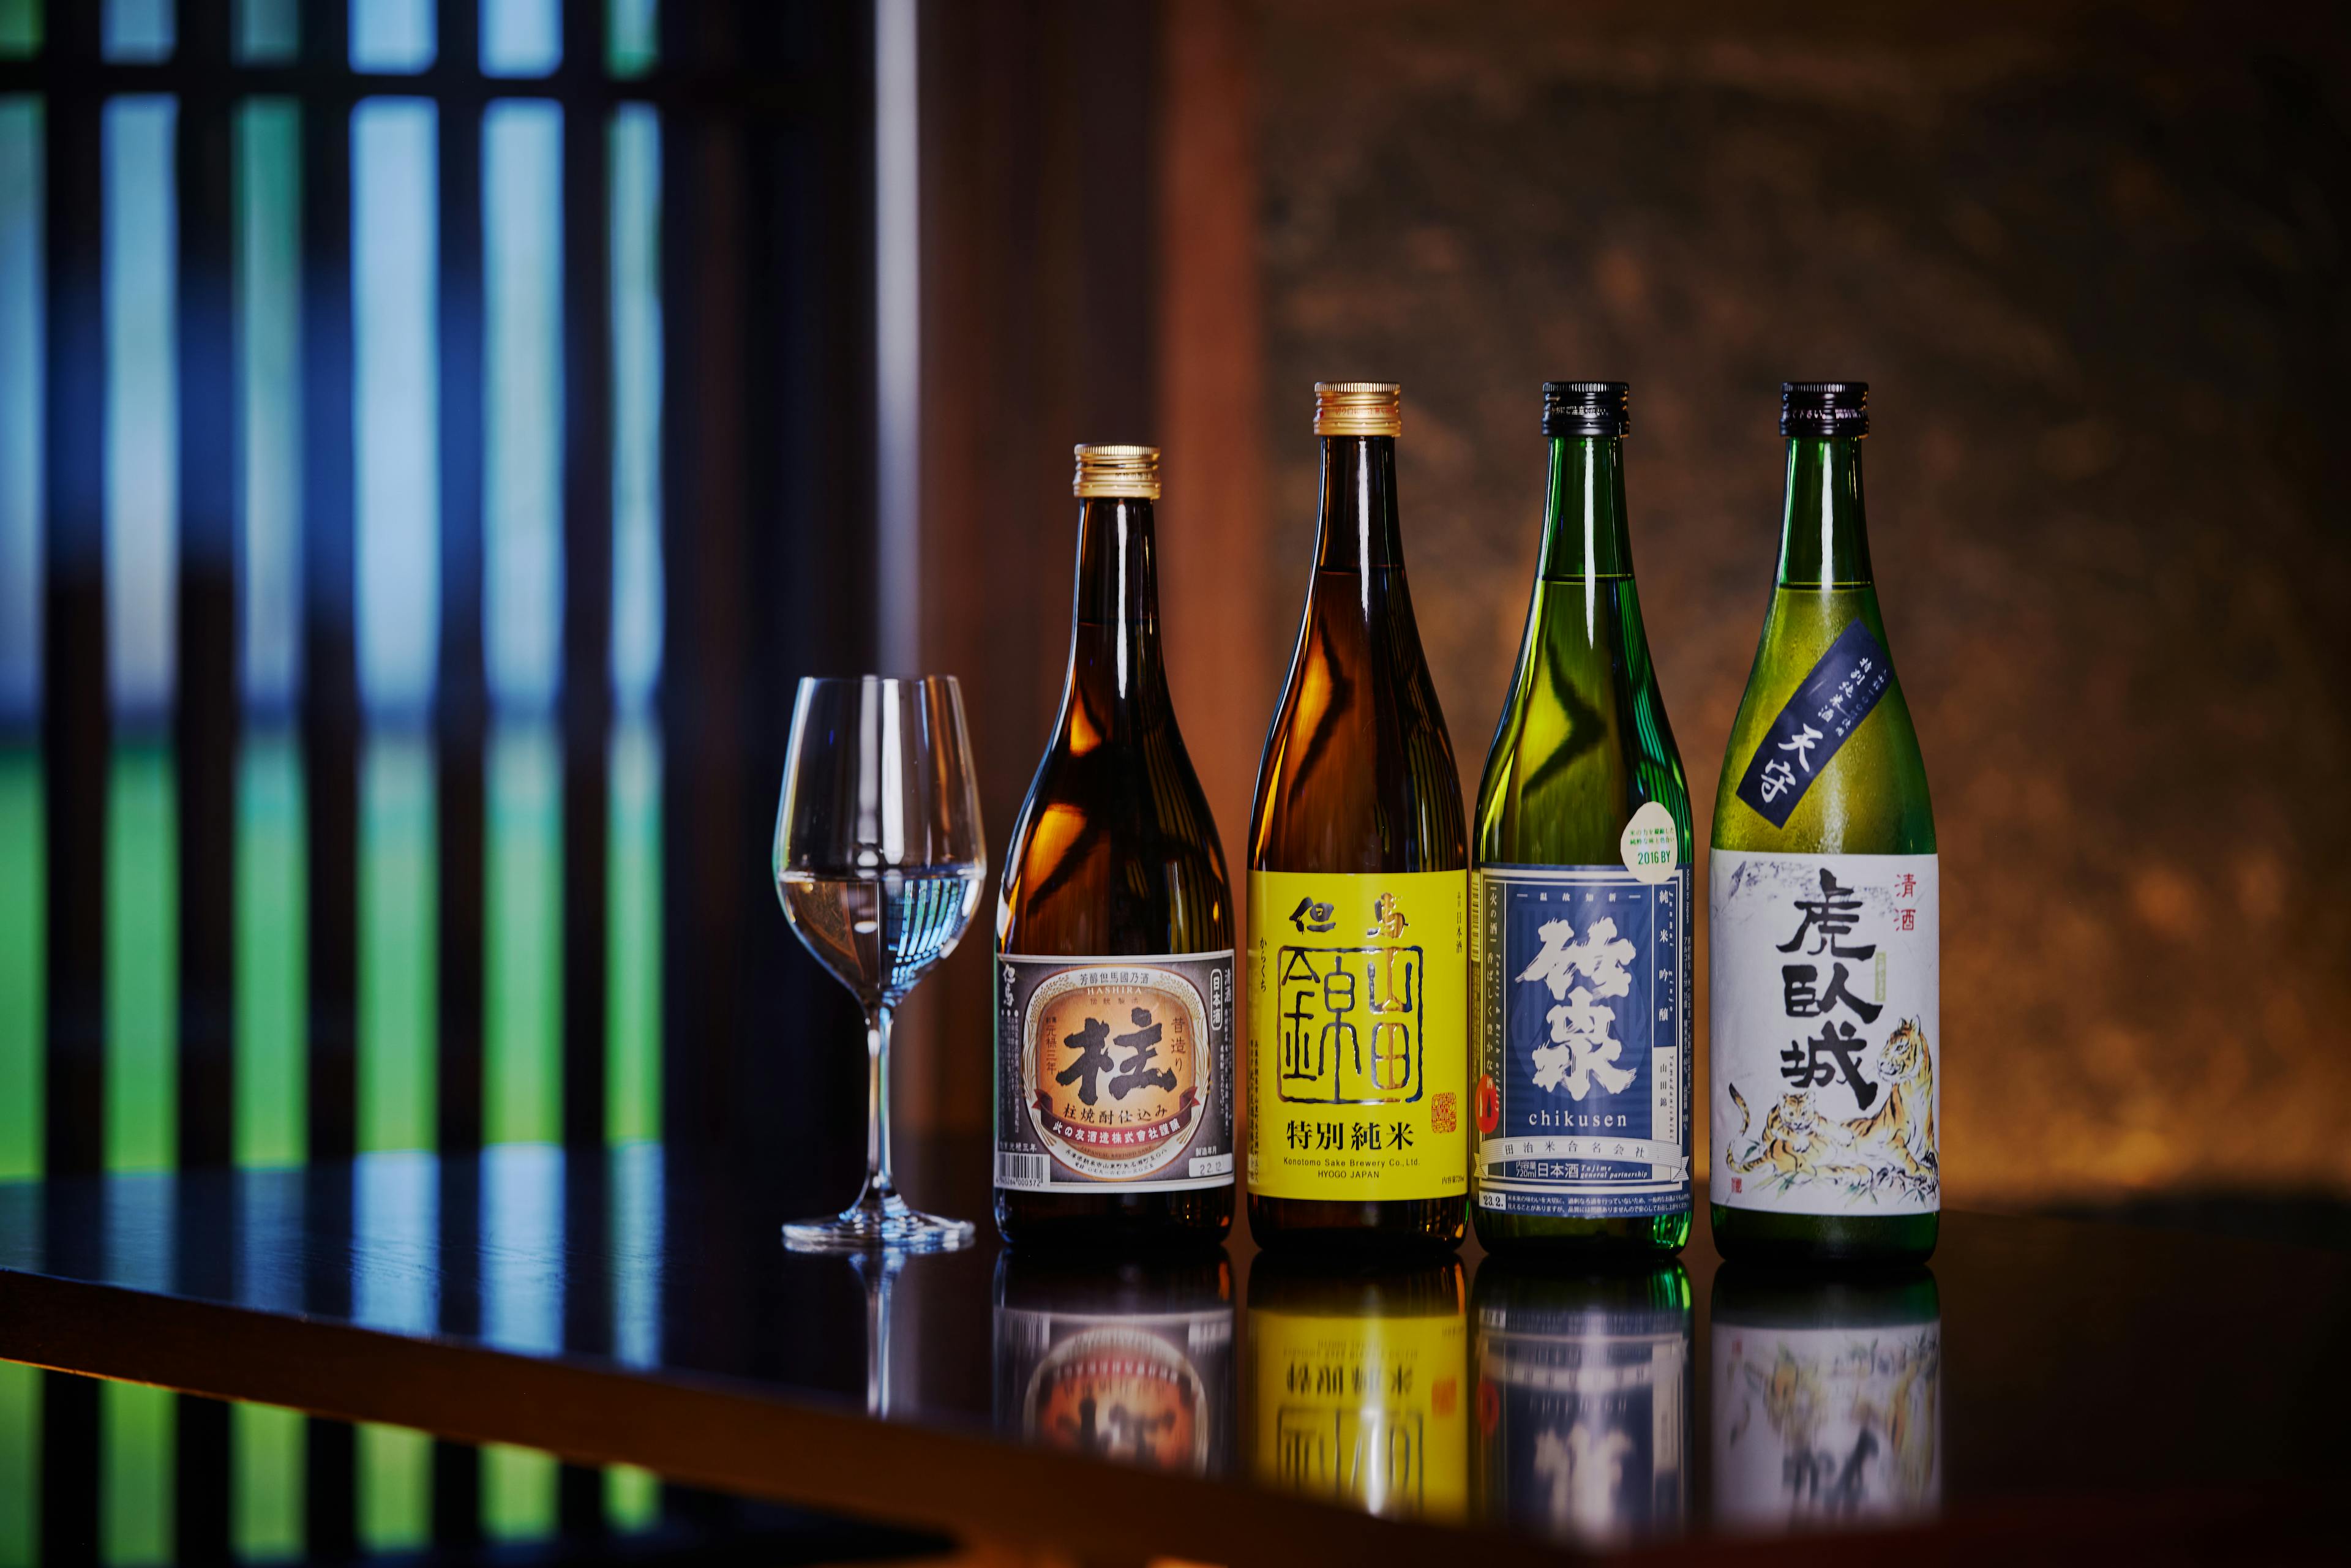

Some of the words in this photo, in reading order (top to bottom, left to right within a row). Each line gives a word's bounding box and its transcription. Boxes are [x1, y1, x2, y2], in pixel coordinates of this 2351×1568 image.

[1817, 658, 1872, 722] 特別純米酒
[1761, 723, 1823, 803] 天守
[1638, 852, 1659, 865] 2016
[1661, 850, 1670, 863] BY
[1894, 874, 1916, 931] 清酒
[1659, 890, 1668, 1022] 純米吟醸
[1080, 971, 1150, 986] 芳醇但馬國乃酒
[1087, 986, 1142, 995] HASHIRA
[1775, 868, 1883, 1111] 虎臥城
[1515, 917, 1637, 1101] 竹泉
[1171, 1016, 1186, 1072] 昔造り
[1056, 1007, 1177, 1106] 柱
[1063, 1104, 1168, 1125] 柱焼酎仕込み
[1529, 1111, 1627, 1128] chikusen
[1286, 1120, 1414, 1151] 特別純米
[1505, 1140, 1644, 1158] 田治米合名会社
[1283, 1157, 1321, 1166] Konotomo
[1325, 1158, 1346, 1166] Sake
[1350, 1158, 1385, 1169] Brewery
[1516, 1161, 1536, 1169] 内容量
[1538, 1162, 1579, 1179] 日本酒
[1018, 1178, 1041, 1187] 000372
[1351, 1170, 1379, 1179] JAPAN
[1516, 1169, 1536, 1179] 720ml
[1580, 1171, 1607, 1180] general
[1610, 1171, 1648, 1180] partnership
